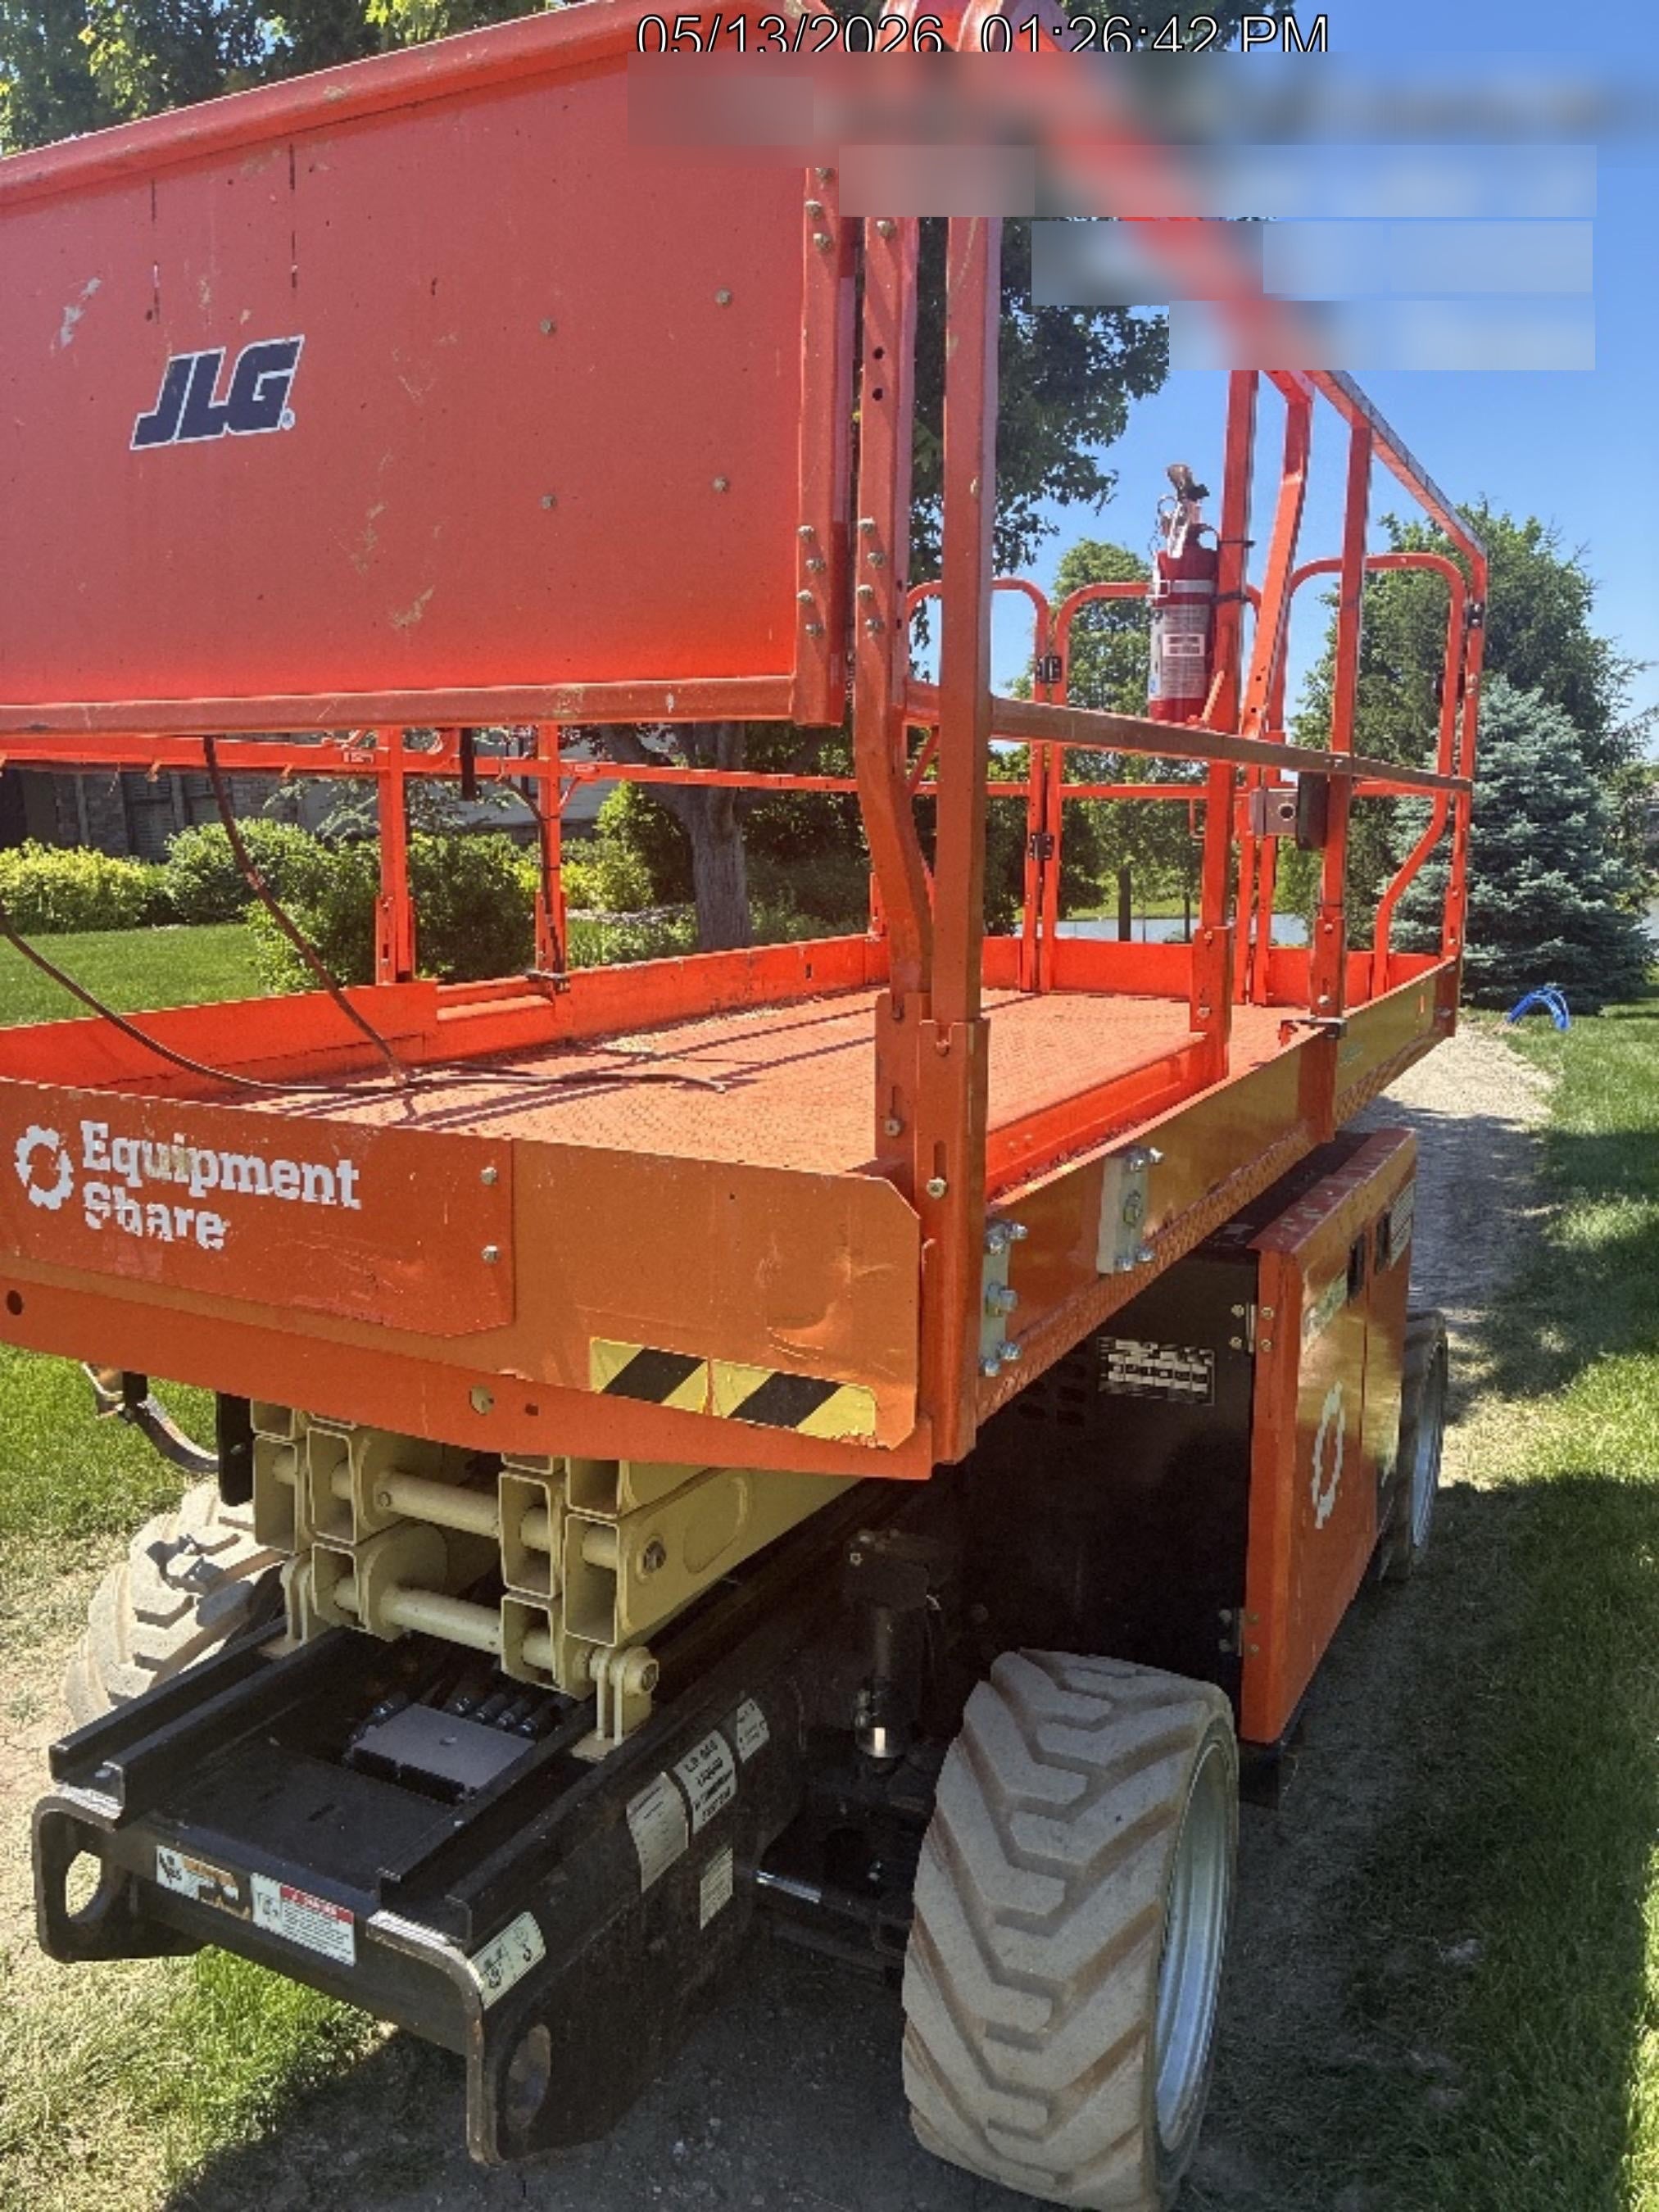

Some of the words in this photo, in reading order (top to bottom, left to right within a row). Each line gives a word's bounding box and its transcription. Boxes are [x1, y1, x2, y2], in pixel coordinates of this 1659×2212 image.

[129, 333, 305, 451] JLG
[80, 1120, 361, 1209] Equipment
[83, 1181, 228, 1250] Share
